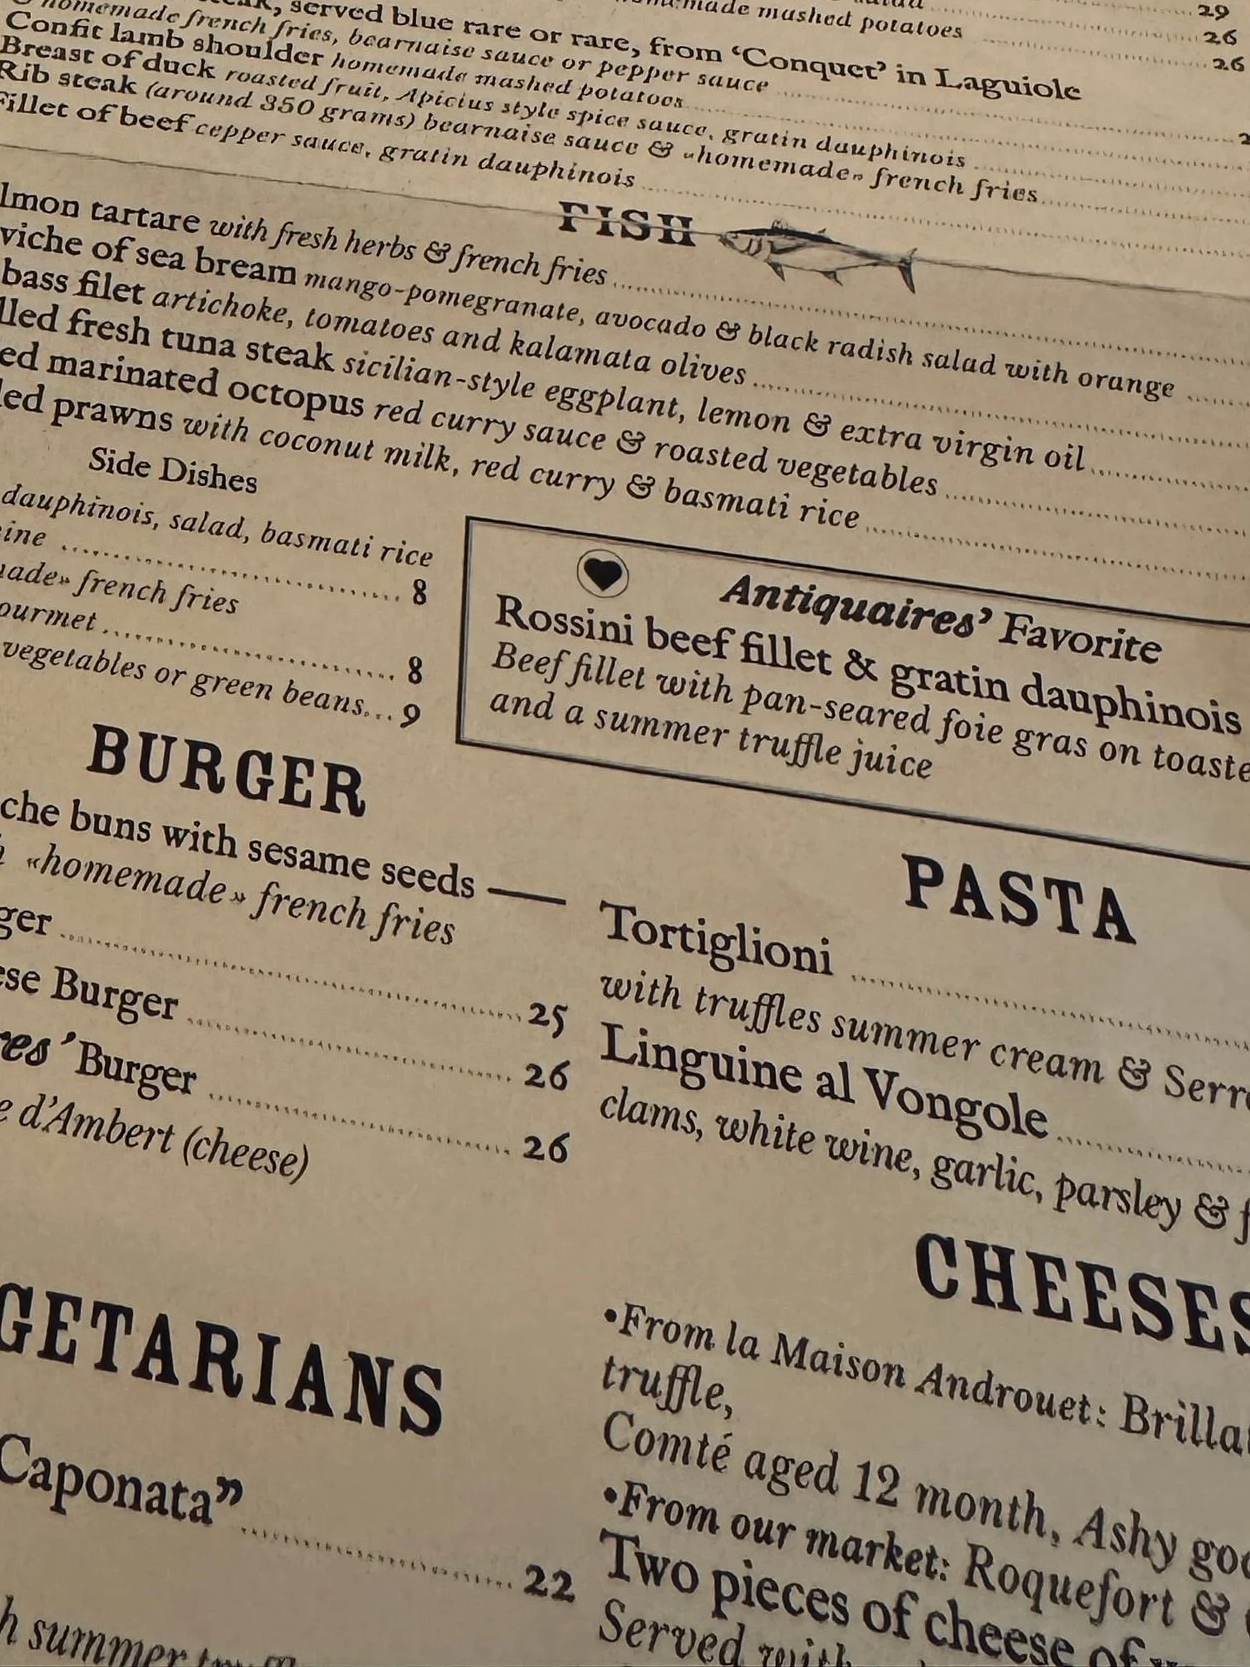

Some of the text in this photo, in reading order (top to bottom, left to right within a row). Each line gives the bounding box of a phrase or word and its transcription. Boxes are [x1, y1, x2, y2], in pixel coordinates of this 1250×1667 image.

[290, 1, 382, 23] served
[393, 6, 453, 30] blue
[463, 21, 521, 38] rare
[530, 29, 562, 43] or
[571, 34, 640, 58] rare,
[650, 37, 722, 62] from
[897, 64, 926, 85] in
[934, 68, 1082, 100] Laguiole
[1198, 5, 1229, 21] 29
[92, 202, 200, 233] tartare
[210, 215, 267, 242] with
[268, 221, 337, 250] fresh
[345, 229, 417, 260] herbs
[424, 241, 451, 264] &
[449, 244, 539, 277] french
[540, 256, 607, 285] fries
[558, 201, 696, 248] FISH
[73, 270, 145, 305] filet
[152, 289, 292, 329] artichoke,
[305, 308, 434, 343] tomatoes
[443, 327, 501, 352] and
[509, 330, 650, 372] kalamata
[661, 352, 746, 384] olives
[89, 447, 257, 494] Side Dishes
[2, 484, 158, 530] dauphinois,
[169, 511, 249, 544] salad,
[261, 521, 370, 558] basmati
[381, 546, 433, 567] rice
[495, 594, 1242, 735] Rossini beef fillet & gratin dauphinois
[719, 575, 1162, 664] Antiquaires’ Favorite
[86, 724, 365, 817] BURGER
[70, 799, 151, 842] buns
[162, 823, 237, 858] with
[248, 840, 370, 880] sesame
[382, 863, 474, 899] seeds
[599, 900, 833, 976] Tortiglioni
[901, 853, 1136, 945] PASTA
[51, 966, 178, 1025] Burger
[525, 1060, 570, 1091] 26
[528, 1003, 568, 1039] 25
[601, 1022, 1048, 1141] Linguine al Vongole
[604, 1411, 1060, 1547] Comté aged 12 month,
[524, 1564, 575, 1603] 22
